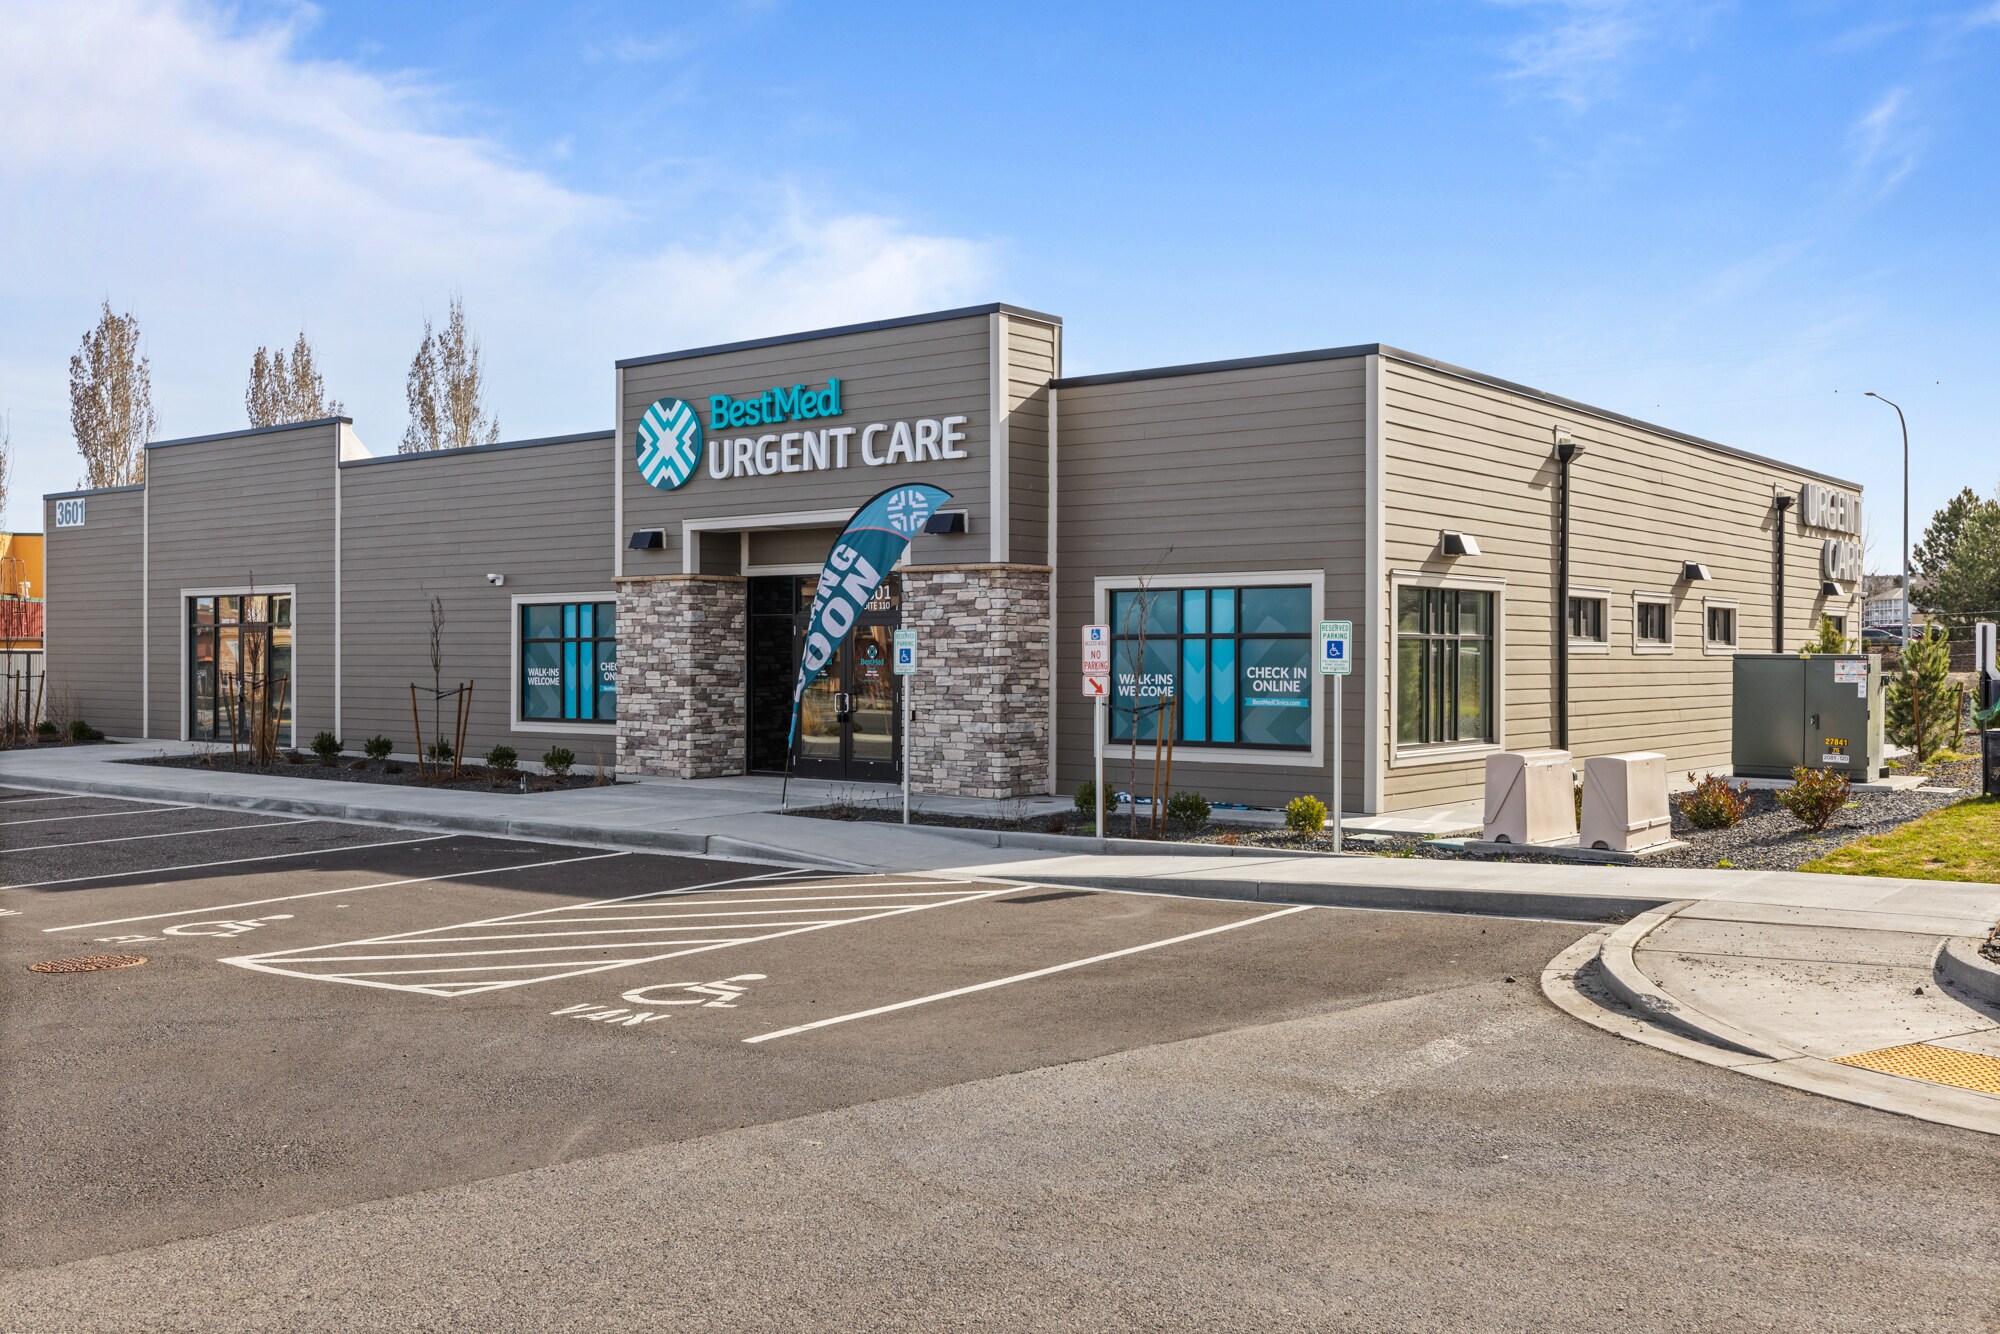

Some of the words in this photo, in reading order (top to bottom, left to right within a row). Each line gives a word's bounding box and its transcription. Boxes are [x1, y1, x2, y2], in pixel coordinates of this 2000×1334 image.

[709, 378, 842, 430] BestMed
[708, 427, 857, 480] URGENT
[861, 416, 968, 466] CARE
[57, 500, 84, 526] 3601
[1803, 483, 1864, 537] URGENT
[1823, 538, 1863, 582] CARE
[871, 584, 891, 600] 01
[1321, 624, 1349, 632] RESERVED
[1322, 632, 1348, 640] PARKING
[1090, 650, 1102, 660] NO
[1084, 661, 1108, 671] PARKING
[527, 667, 560, 678] WALK-INS
[1246, 666, 1290, 679] CHECK
[1293, 667, 1307, 679] IN
[527, 677, 560, 686] WELCOME
[1252, 680, 1301, 692] ONLINE
[1825, 737, 1848, 747] 27841
[549, 1003, 672, 1026] VAN
